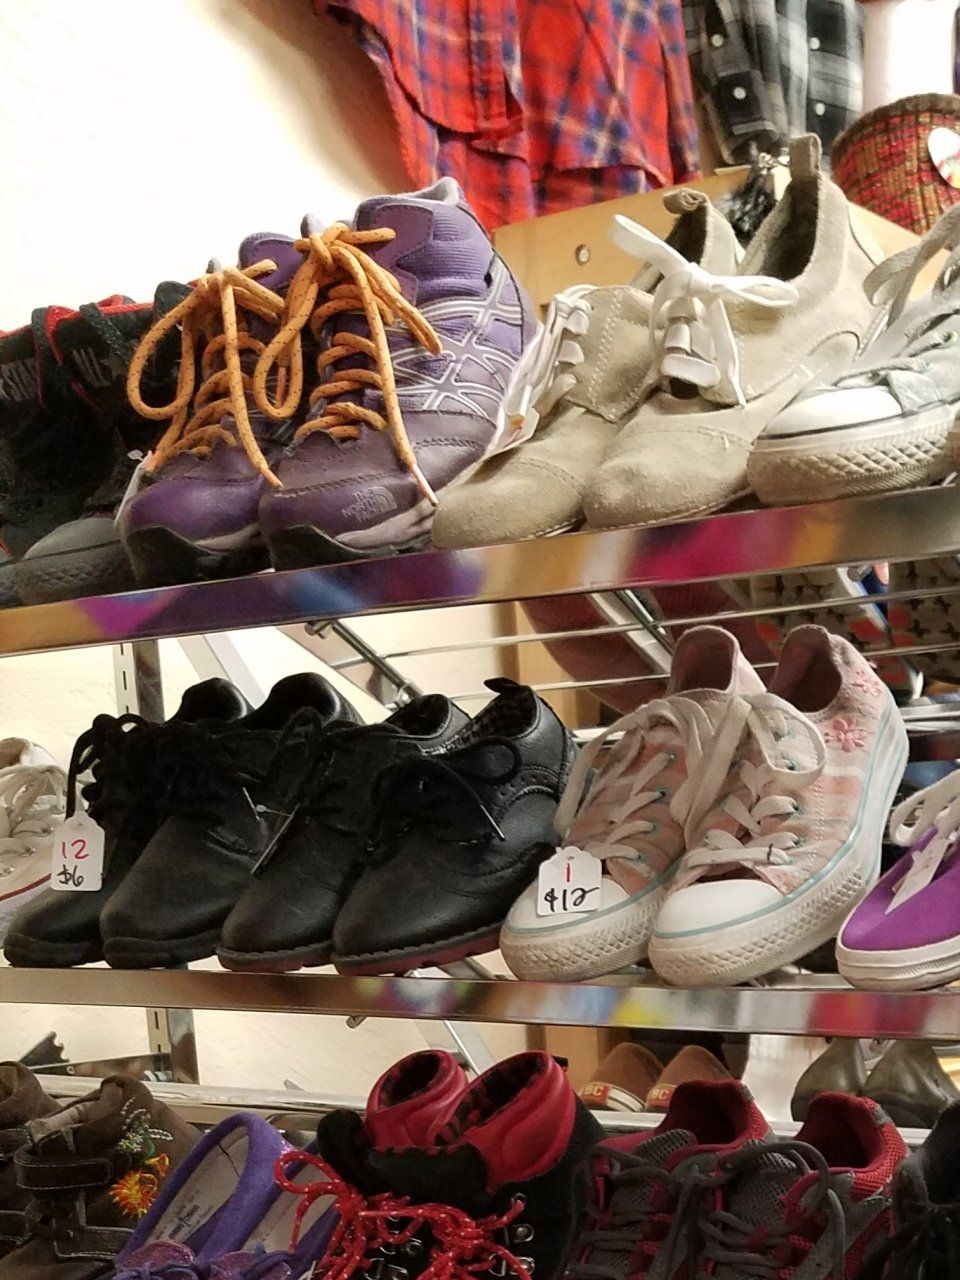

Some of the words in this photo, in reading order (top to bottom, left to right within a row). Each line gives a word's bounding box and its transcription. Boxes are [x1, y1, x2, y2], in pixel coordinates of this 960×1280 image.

[61, 838, 90, 859] 12
[56, 863, 84, 887] $6
[543, 887, 600, 913] $12
